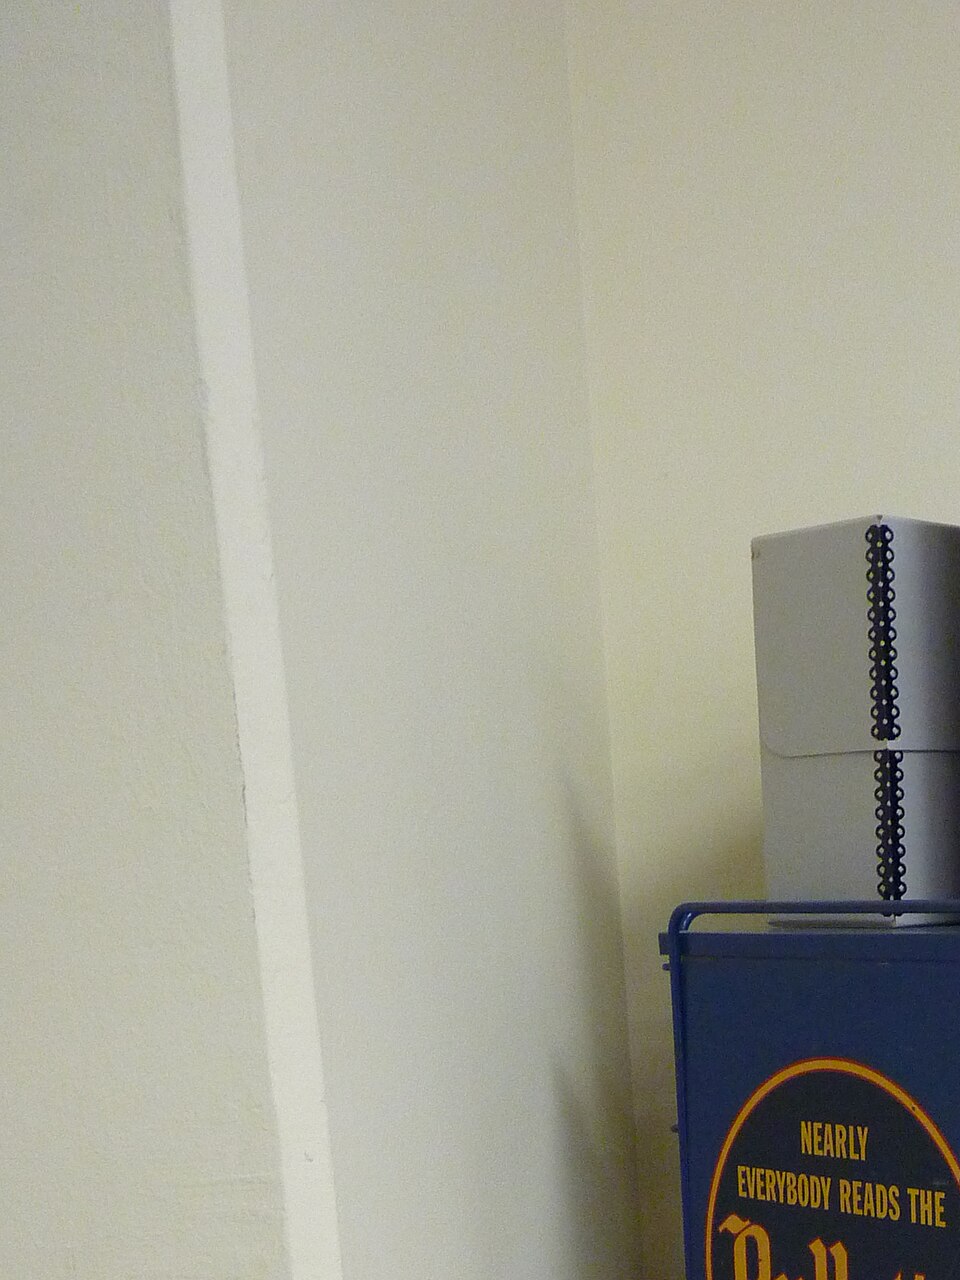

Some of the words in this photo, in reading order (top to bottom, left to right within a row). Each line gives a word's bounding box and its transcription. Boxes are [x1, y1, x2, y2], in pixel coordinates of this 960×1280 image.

[800, 1120, 869, 1161] NEARLY
[737, 1165, 832, 1212] EVERYBODY
[839, 1179, 901, 1221] READS
[907, 1187, 947, 1228] THE
